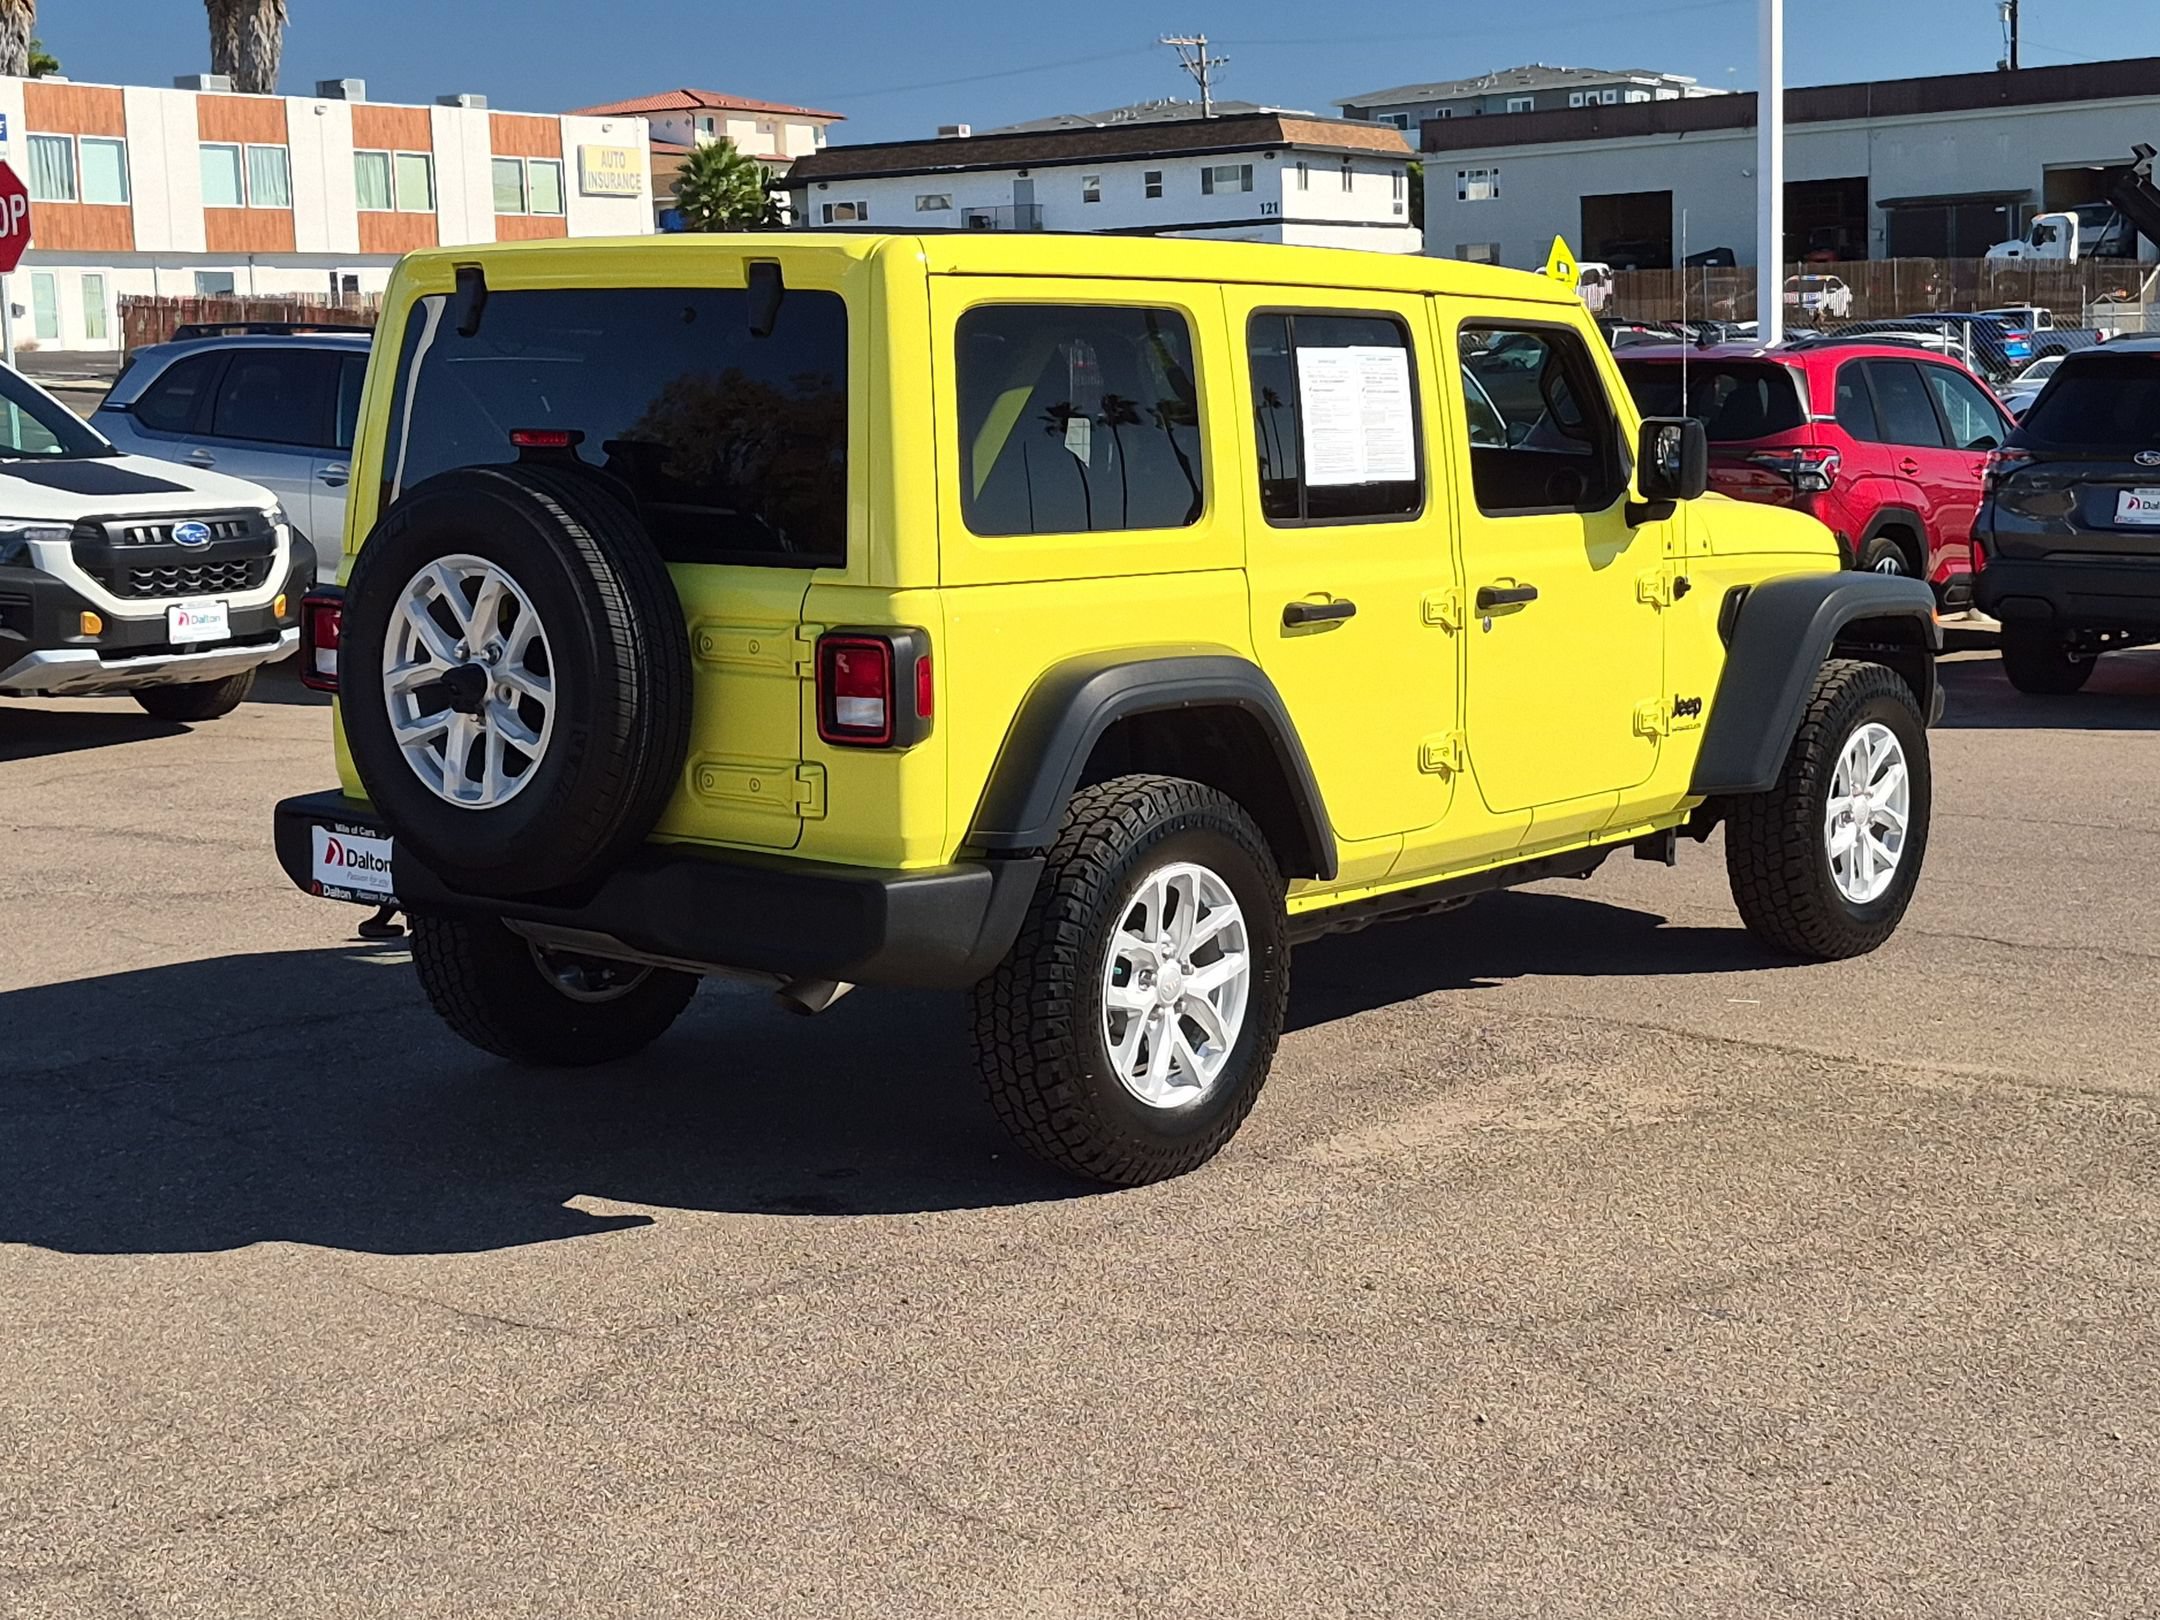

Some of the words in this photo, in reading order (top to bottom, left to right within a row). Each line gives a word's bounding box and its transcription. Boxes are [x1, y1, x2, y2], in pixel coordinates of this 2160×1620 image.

[601, 151, 625, 169] AUTO
[587, 171, 641, 190] INSURANCE
[1260, 201, 1278, 215] 121
[191, 614, 221, 625] Dalton
[1671, 693, 1702, 720] Jeep
[346, 848, 391, 873] Dalton
[323, 884, 352, 901] Dalton
